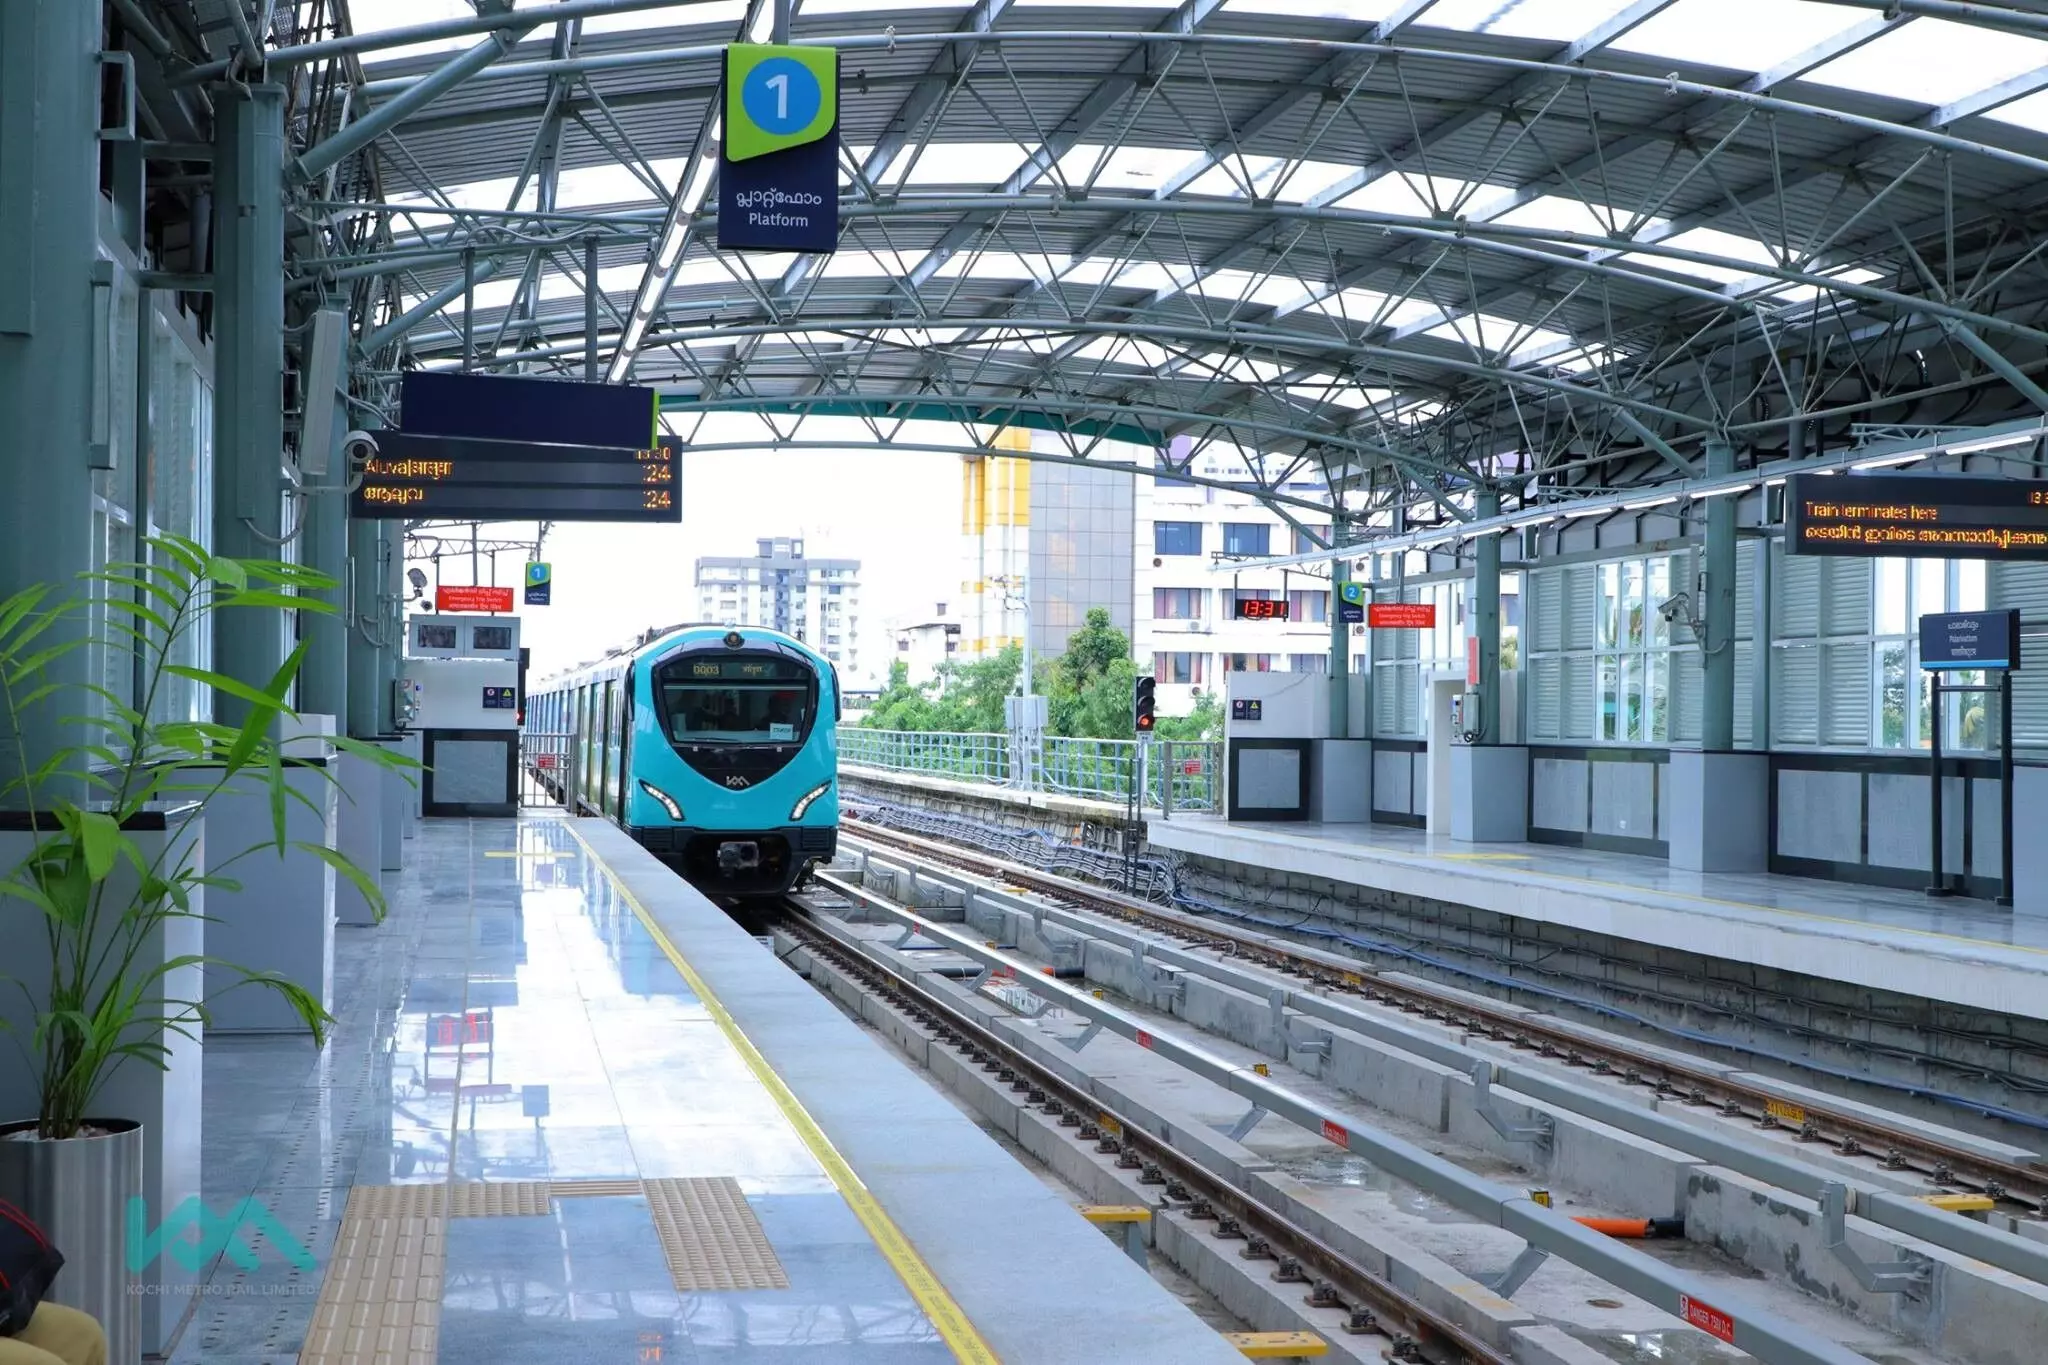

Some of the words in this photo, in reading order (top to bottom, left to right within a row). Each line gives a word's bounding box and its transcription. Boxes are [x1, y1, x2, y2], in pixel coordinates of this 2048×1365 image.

[765, 74, 788, 119] 1
[749, 212, 808, 227] Platform
[1805, 501, 1839, 517] Train
[1842, 504, 1907, 520] terminates
[1911, 505, 1937, 520] here
[534, 567, 540, 578] 1
[1348, 587, 1356, 598] 2
[1244, 601, 1285, 616] 13:31
